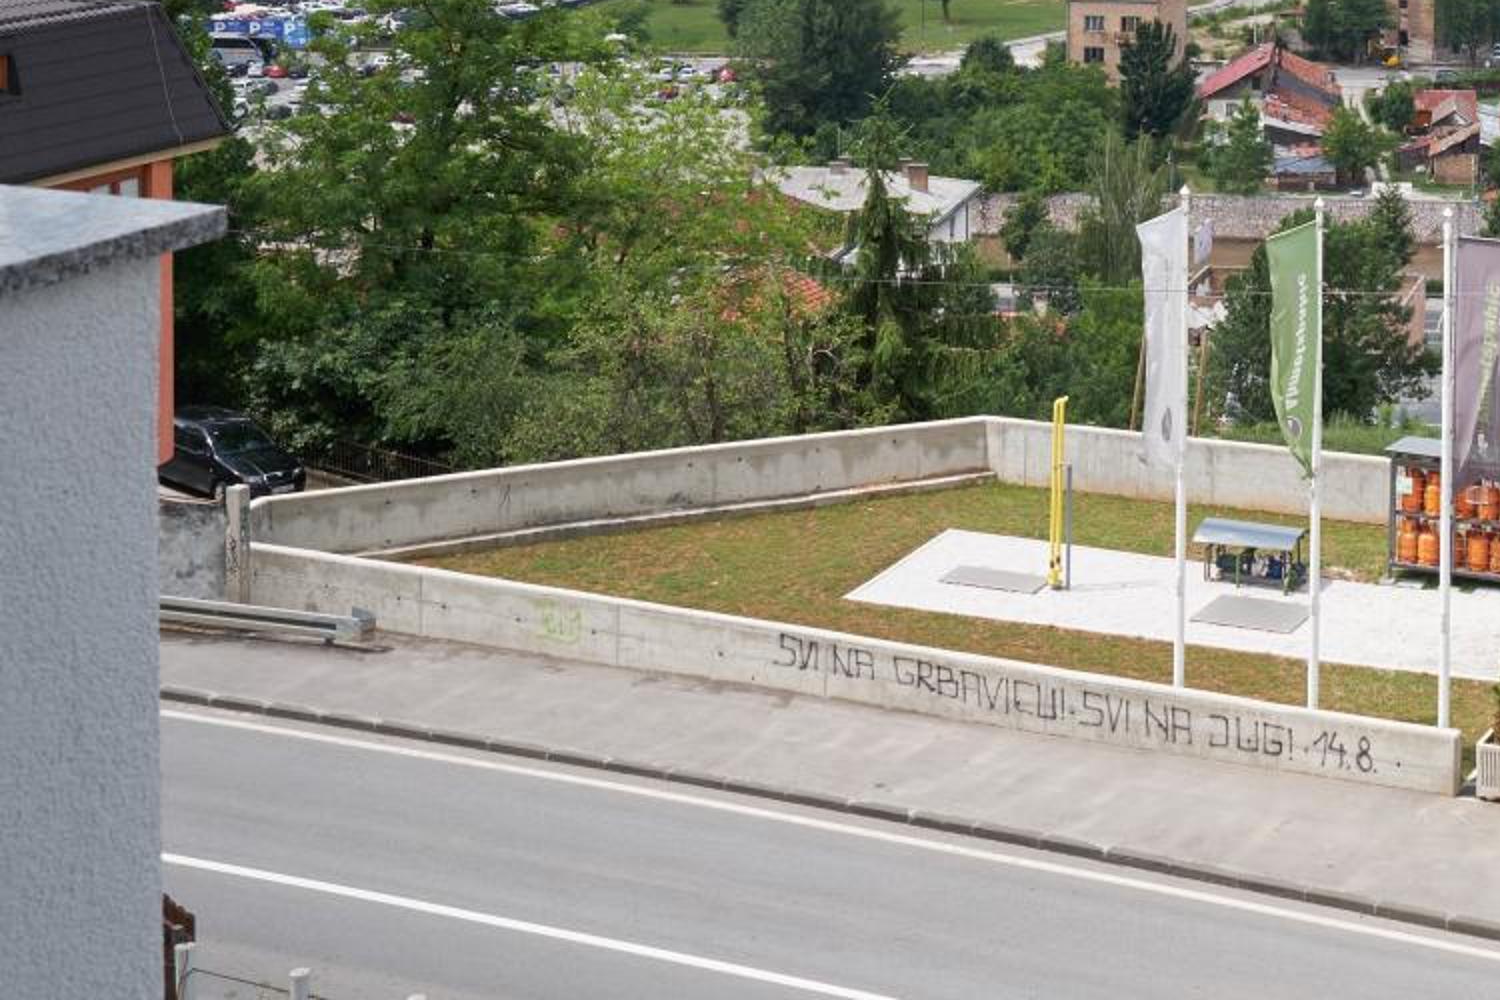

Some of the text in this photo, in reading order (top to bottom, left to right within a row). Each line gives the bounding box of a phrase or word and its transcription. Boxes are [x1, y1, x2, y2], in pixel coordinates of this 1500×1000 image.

[772, 632, 819, 671] SVI
[832, 643, 875, 680] NA
[1079, 688, 1130, 734] SVI
[1144, 698, 1193, 746] NA
